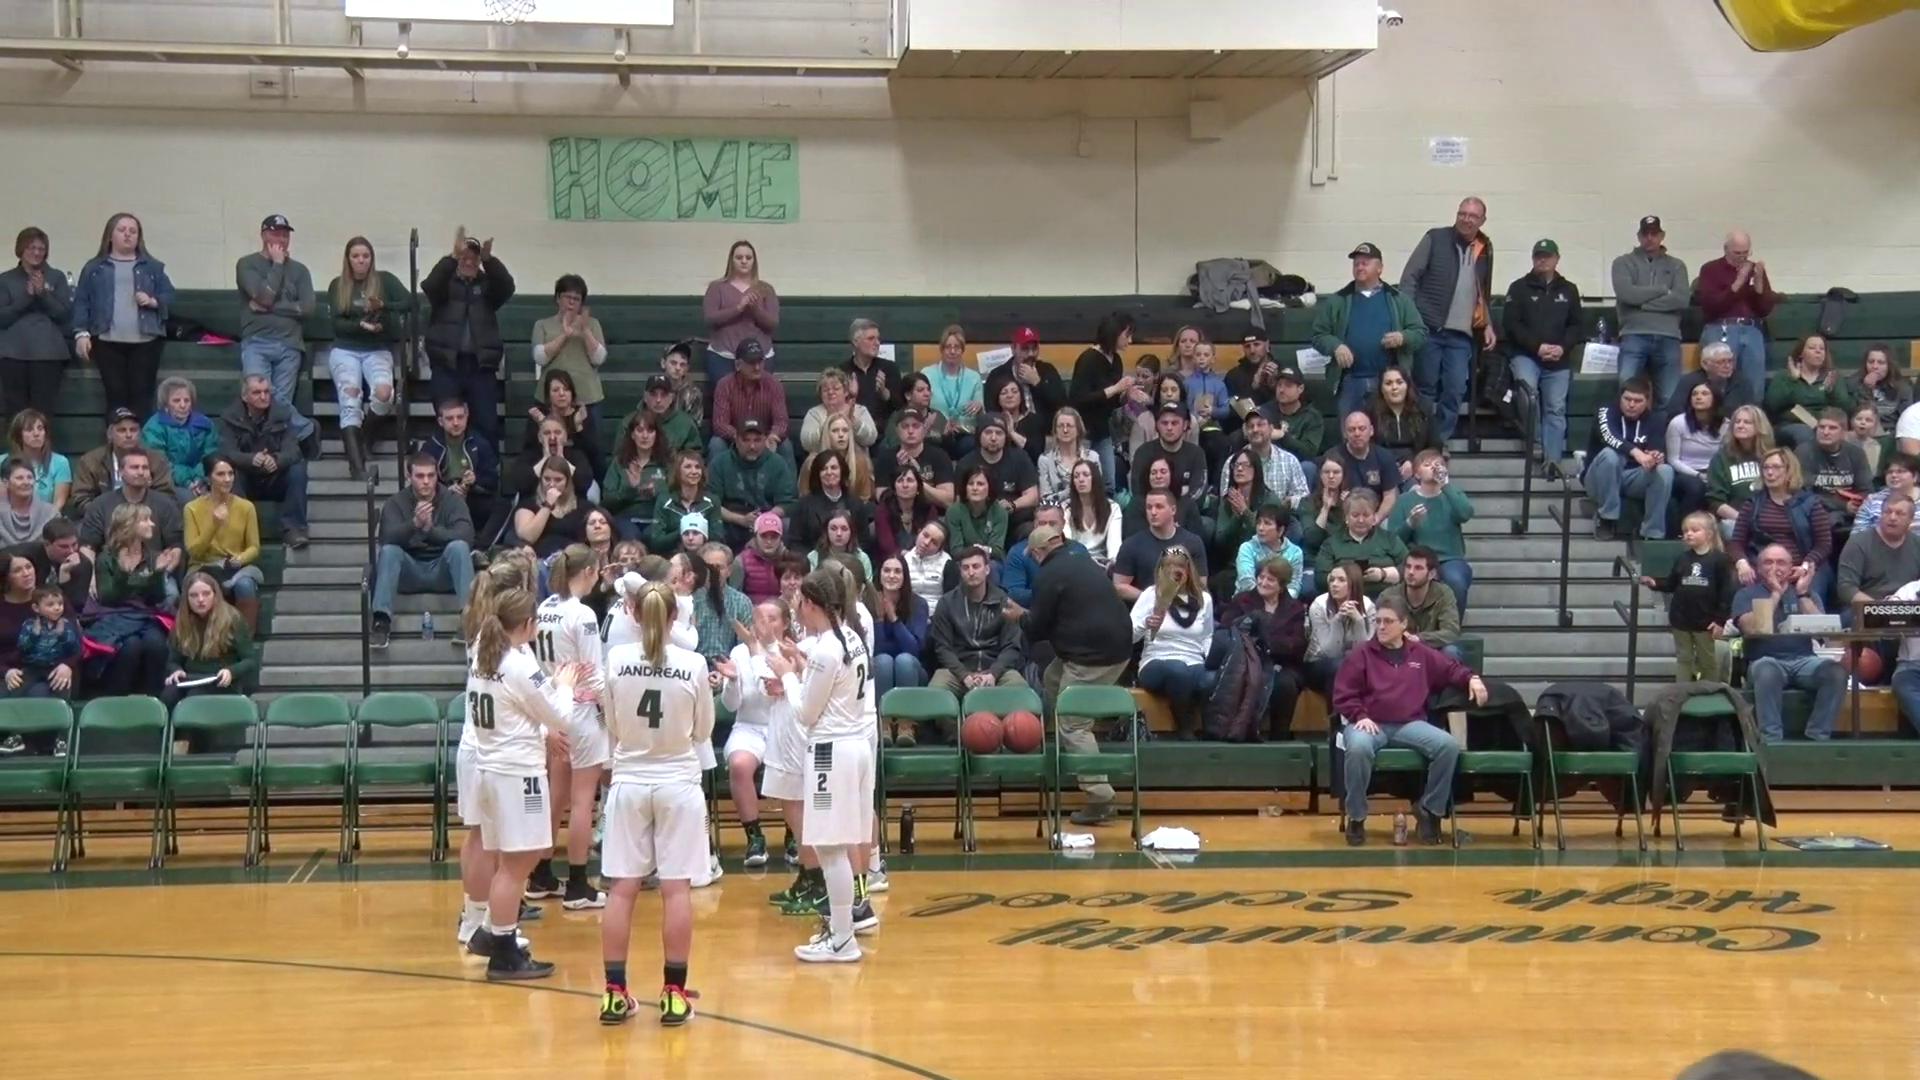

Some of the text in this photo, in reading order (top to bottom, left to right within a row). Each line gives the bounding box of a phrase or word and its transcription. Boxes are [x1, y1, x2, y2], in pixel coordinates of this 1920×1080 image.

[549, 137, 791, 220] HOME
[538, 630, 555, 662] 11
[618, 665, 692, 681] JANDREAU
[856, 663, 866, 701] 2
[469, 691, 495, 730] 30
[636, 689, 664, 729] 4
[817, 772, 828, 792] 2
[907, 881, 1836, 917] High School
[988, 918, 1821, 951] Community
